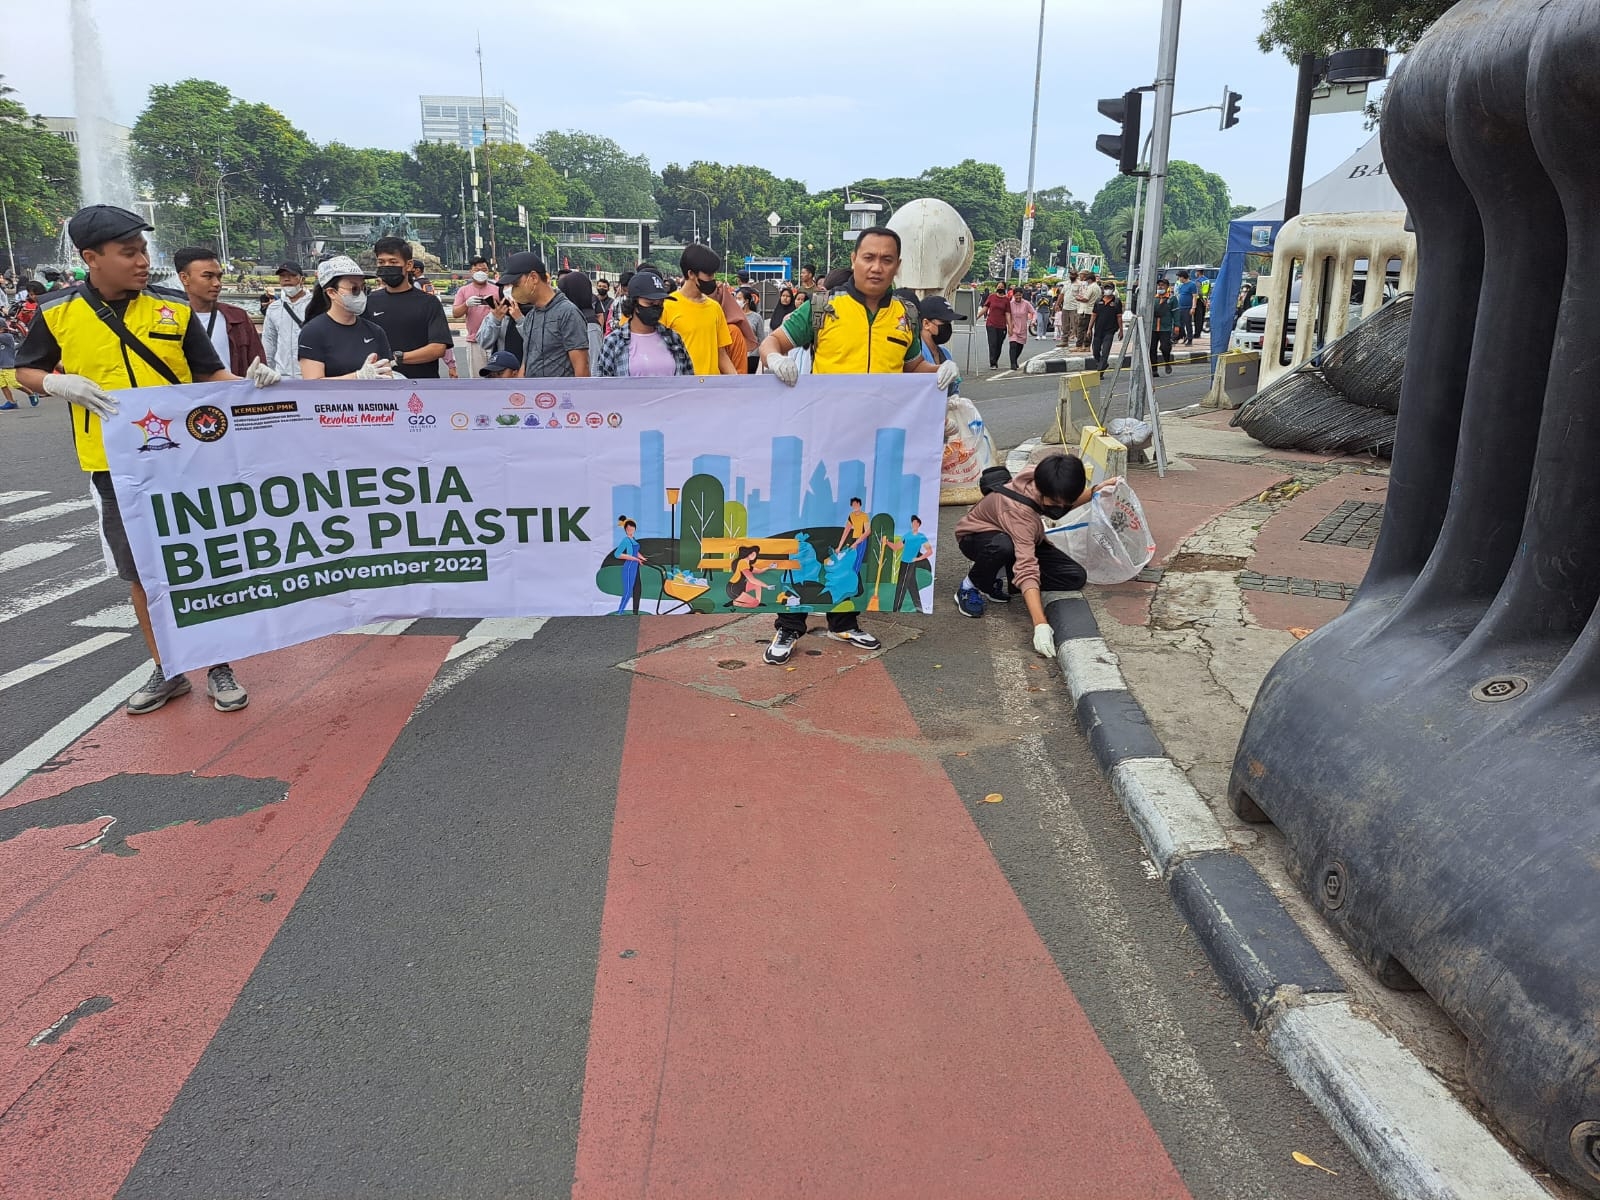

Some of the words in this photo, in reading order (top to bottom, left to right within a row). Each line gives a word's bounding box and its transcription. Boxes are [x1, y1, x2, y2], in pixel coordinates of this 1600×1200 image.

[234, 405, 274, 415] KEMENKO
[276, 403, 295, 411] PMK
[314, 403, 354, 413] GERAKAN
[357, 402, 400, 412] NASIONAL
[319, 412, 358, 425] Revolusi
[360, 411, 395, 423] Mental
[408, 414, 437, 426] G20
[150, 465, 474, 537] INDONESIA
[160, 515, 355, 587] BEBAS
[367, 506, 592, 550] PLASTIK
[178, 581, 279, 615] Jakarta,
[281, 573, 311, 594] 06
[314, 559, 431, 587] November
[433, 556, 484, 573] 2022
